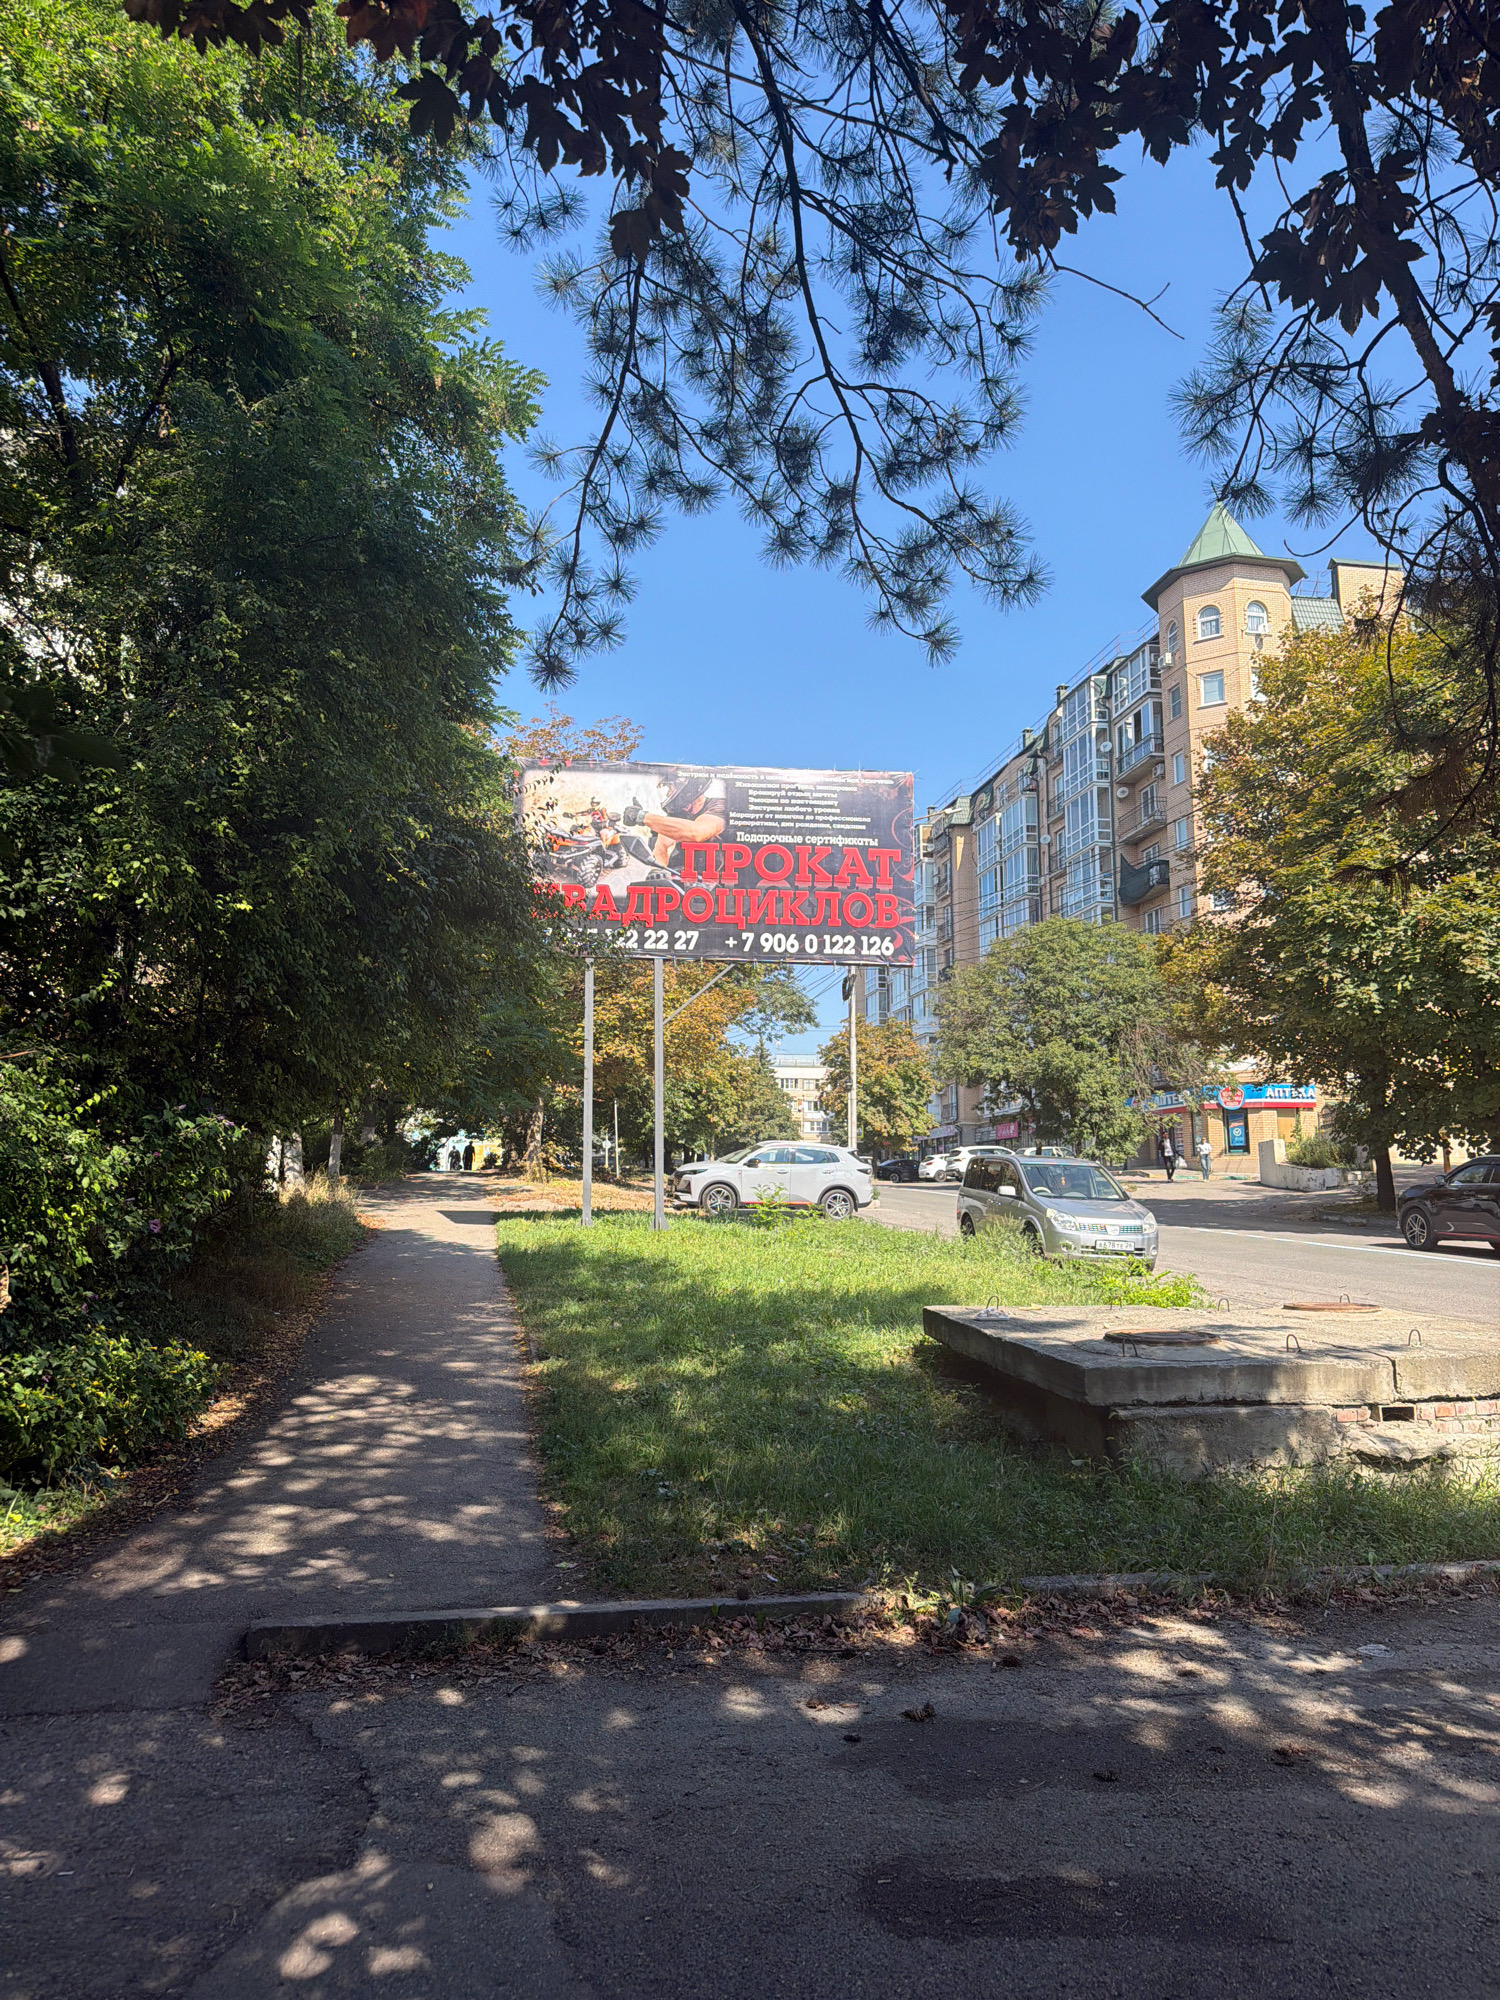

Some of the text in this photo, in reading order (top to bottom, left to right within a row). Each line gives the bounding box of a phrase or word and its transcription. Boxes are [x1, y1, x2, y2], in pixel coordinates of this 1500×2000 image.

[677, 771, 708, 779] Экстрим
[735, 781, 780, 789] Живописная
[748, 788, 786, 797] Бронируй
[748, 797, 783, 805] Эмоции
[791, 798, 839, 807] настоящему
[748, 804, 783, 813] Экстрим
[813, 807, 841, 815] уровня
[729, 811, 764, 820] Маршрут
[815, 814, 871, 823] профессионала
[729, 819, 779, 828] Корпоративы,
[736, 831, 879, 847] Подарочные сертификаты
[680, 842, 902, 886] ПРОКАТ
[643, 929, 669, 950] 22
[674, 930, 699, 950] 27
[760, 932, 800, 953] 906
[804, 934, 818, 954] 0
[823, 935, 856, 955] 122
[861, 936, 895, 956] 126
